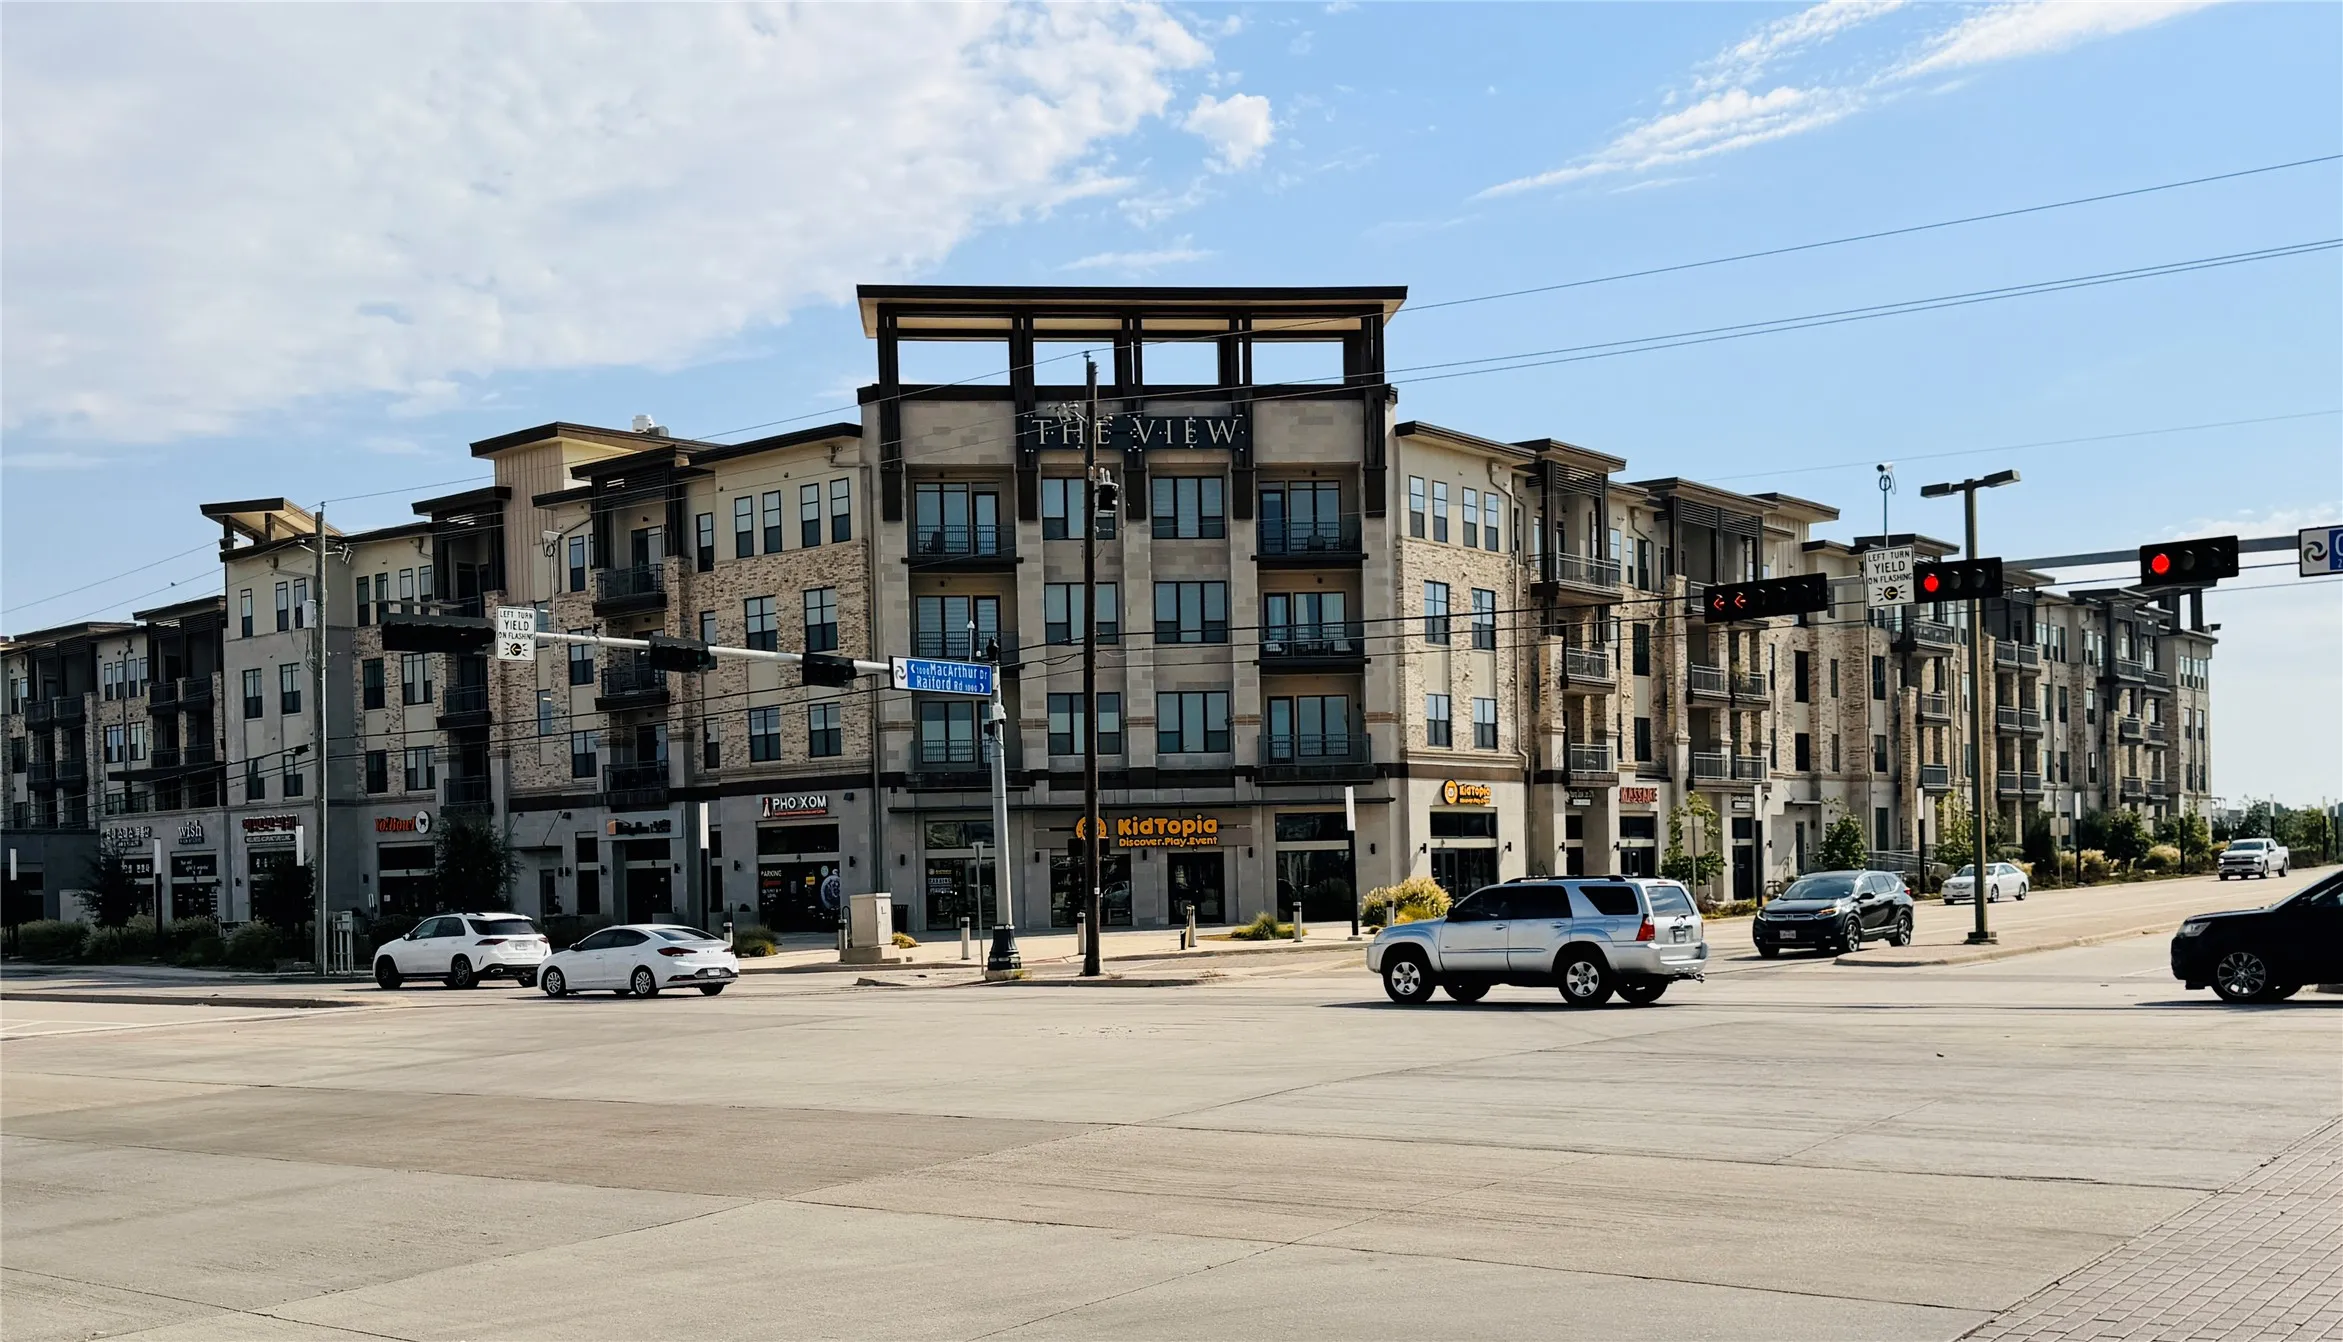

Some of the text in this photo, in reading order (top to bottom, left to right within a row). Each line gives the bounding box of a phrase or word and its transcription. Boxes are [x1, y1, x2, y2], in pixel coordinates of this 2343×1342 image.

[1031, 418, 1239, 445] THE VIEW
[1868, 550, 1910, 562] LEFT TURN
[1874, 560, 1906, 574] YIELD
[1868, 572, 1913, 585] ON FLASHING
[500, 610, 533, 619] LEFT TURN
[504, 620, 530, 631] YIELD
[498, 631, 535, 641] ON FLASHING
[929, 663, 978, 679] MacArthur
[979, 669, 988, 680] Dr
[916, 676, 951, 690] Raiford
[953, 682, 963, 691] Rd
[772, 795, 827, 810] PHO XOM
[178, 820, 203, 838] wish
[1117, 814, 1218, 838] KidTopia
